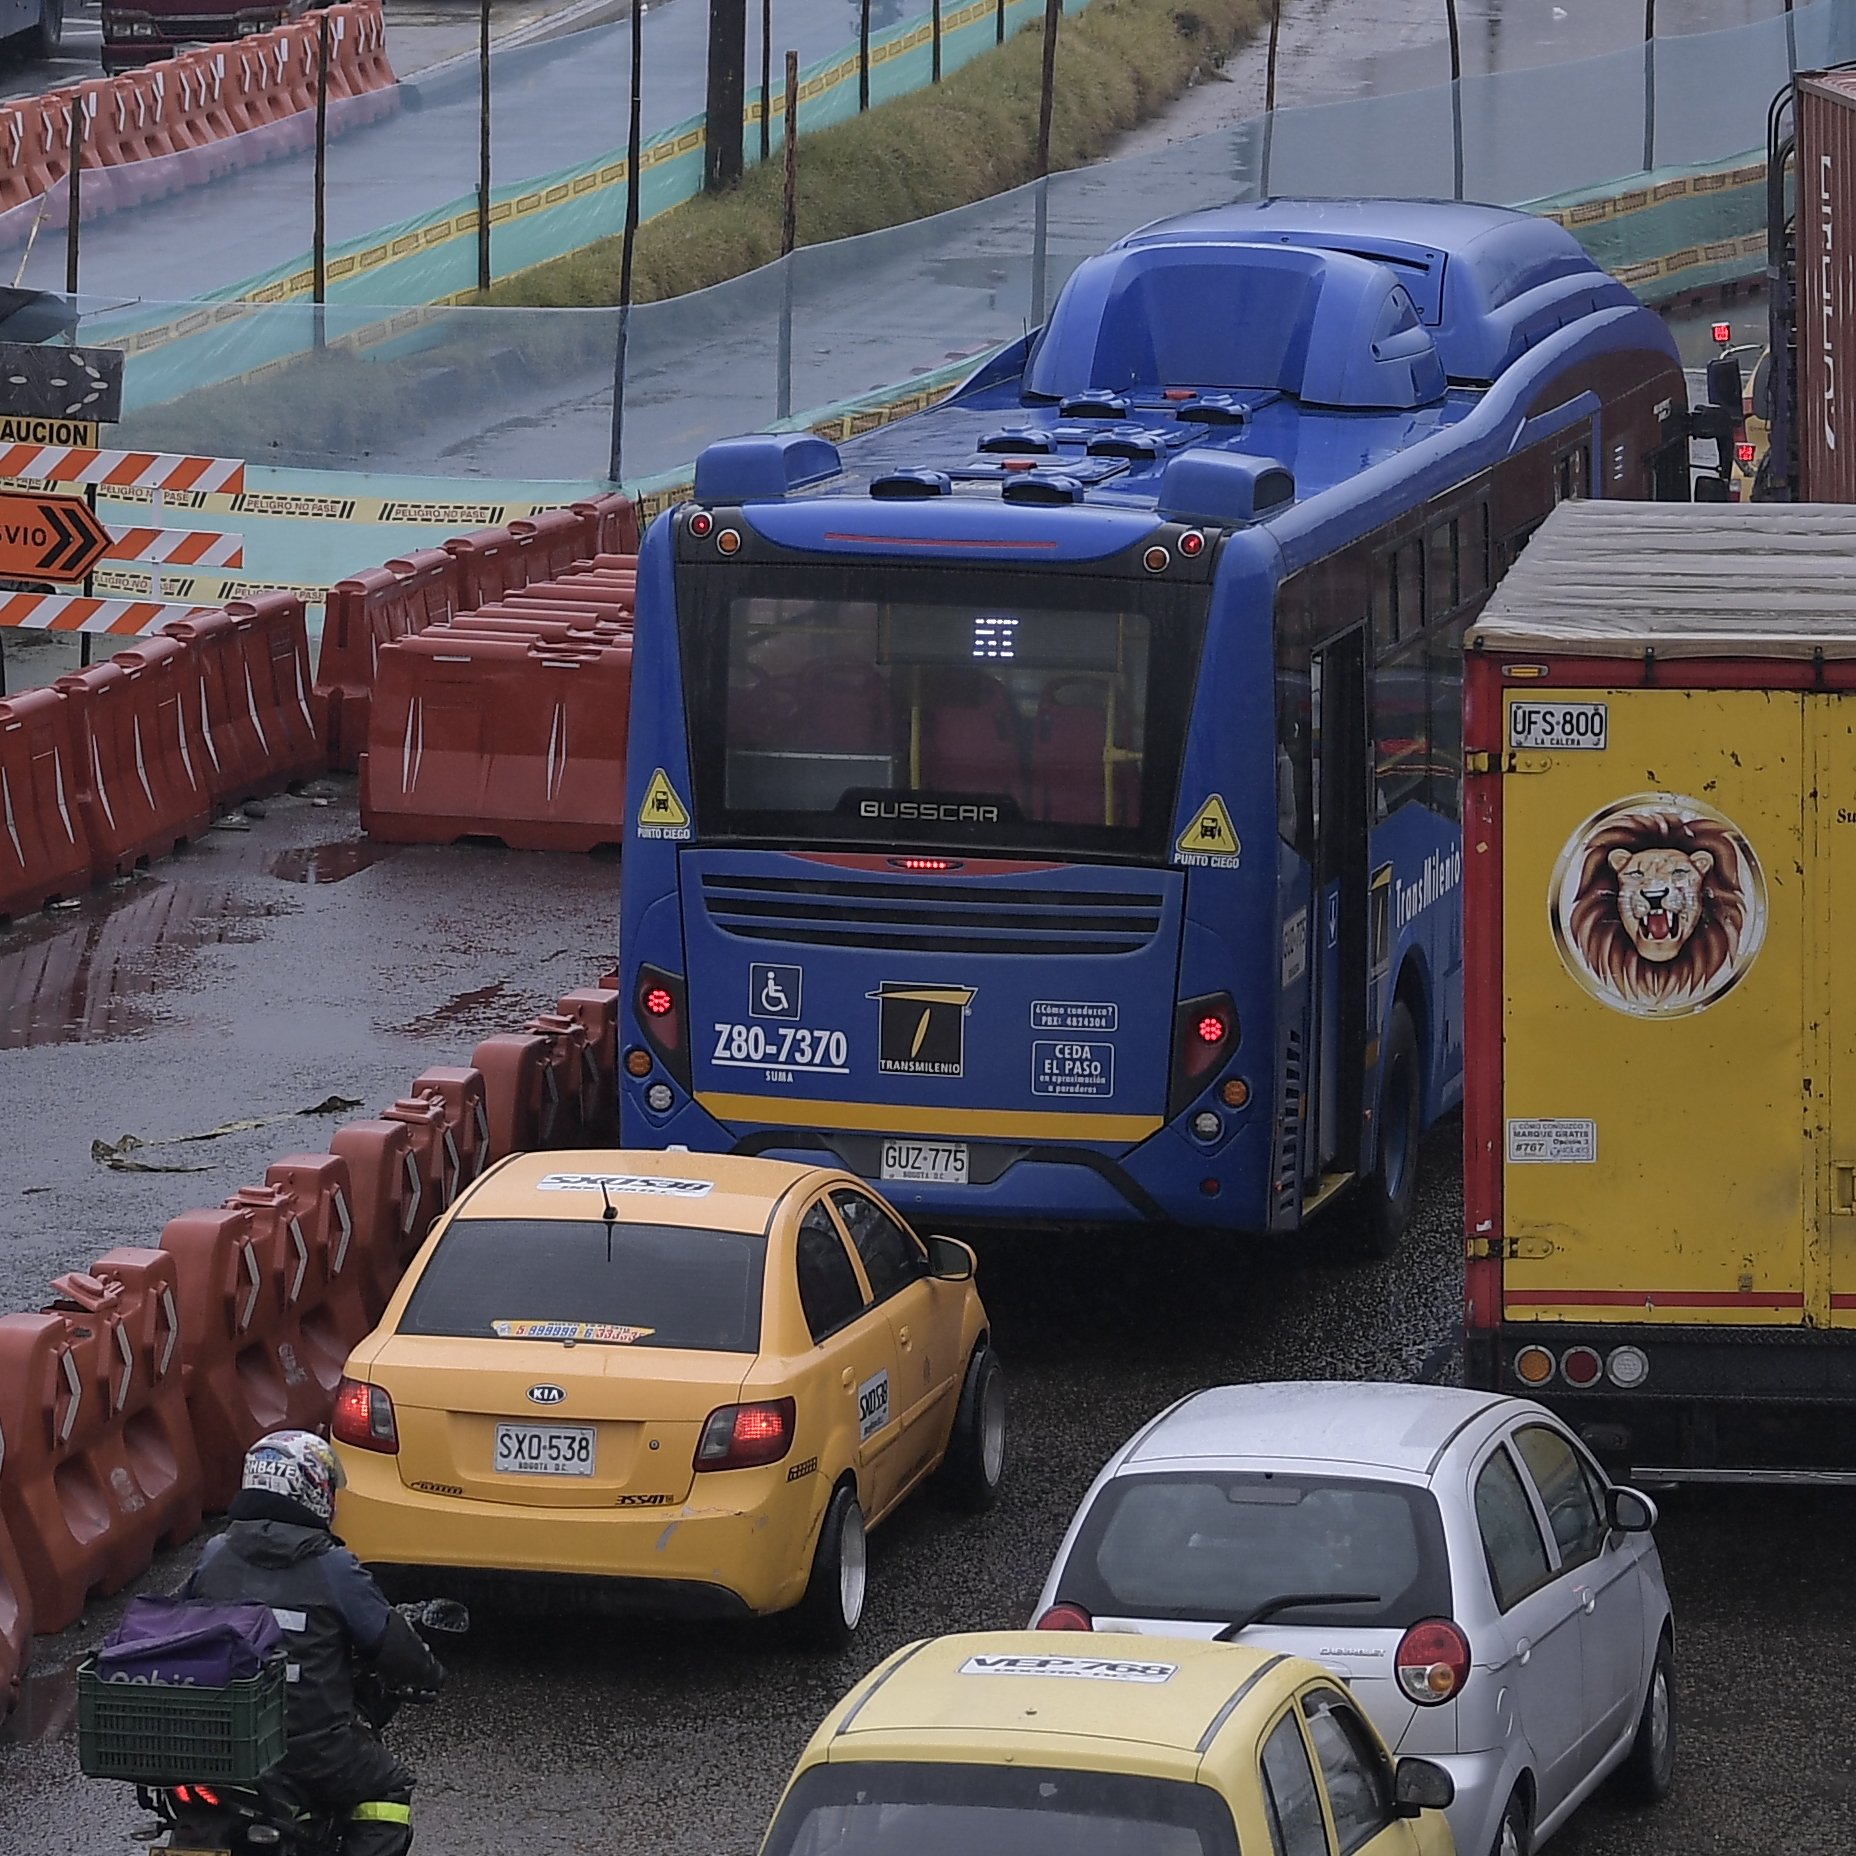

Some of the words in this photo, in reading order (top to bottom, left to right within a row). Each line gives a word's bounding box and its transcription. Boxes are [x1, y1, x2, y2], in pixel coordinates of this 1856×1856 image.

[100, 484, 143, 497] PELIGRO
[163, 491, 190, 502] PASE
[246, 499, 293, 511] PELIGRO
[295, 502, 310, 512] NO
[312, 503, 337, 513] PASE
[395, 507, 441, 518] PELIGRO
[444, 509, 458, 519] NO
[94, 574, 130, 588] ELIGRO
[132, 578, 148, 588] NO
[159, 581, 177, 592] ASE
[1535, 738, 1545, 746] LA
[1550, 738, 1581, 746] CALERA
[859, 799, 1000, 823] BUSSCAR
[663, 828, 691, 841] CIEGO
[1174, 853, 1211, 867] PUNTO
[1212, 855, 1240, 869] CIEGO
[1396, 841, 1460, 929] TransMilenio
[1041, 1016, 1061, 1025] PBX:
[713, 1022, 848, 1066] Z80-7370
[1055, 1044, 1092, 1059] CEDA
[879, 1059, 961, 1075] TRANSMILENIO
[1044, 1059, 1060, 1074] EL
[1065, 1060, 1102, 1075] PASO
[765, 1071, 794, 1083] SUMA
[1055, 1084, 1097, 1094] paraderos
[1513, 1130, 1553, 1138] MARQUE
[1555, 1130, 1589, 1138] GRATIS
[1515, 1142, 1545, 1152] #767
[533, 1388, 560, 1400] KIA
[518, 1461, 548, 1471] BOGOTA
